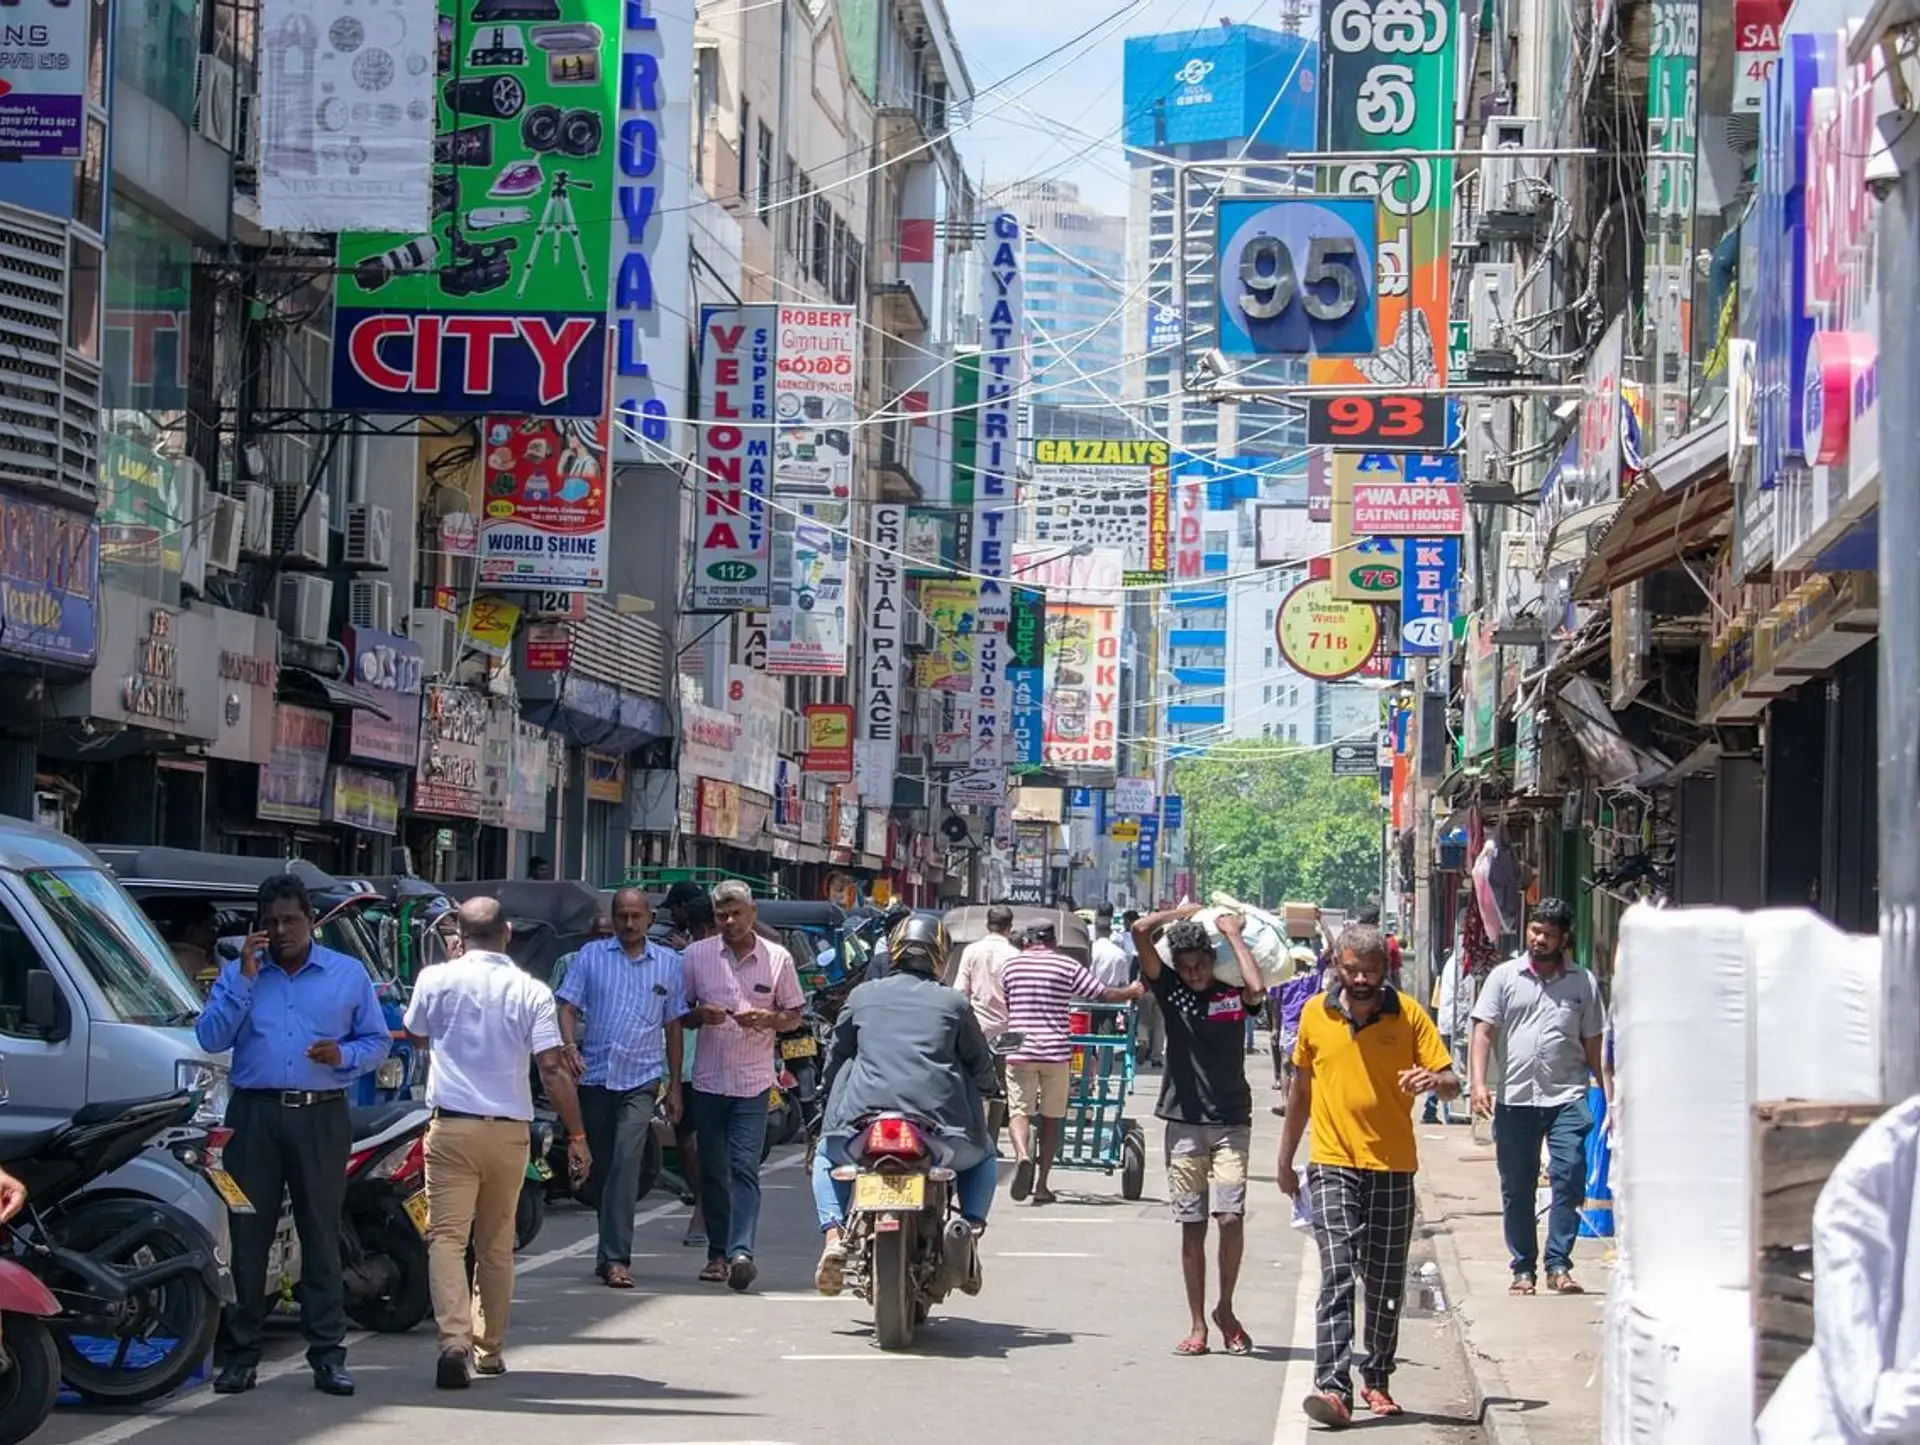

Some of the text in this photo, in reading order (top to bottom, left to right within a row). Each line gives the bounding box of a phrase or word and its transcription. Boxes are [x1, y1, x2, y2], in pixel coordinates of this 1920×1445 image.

[614, 52, 658, 377] ROYAL
[1238, 234, 1357, 322] 95
[781, 310, 851, 327] ROBERT
[349, 314, 596, 405] CITY
[703, 325, 746, 549] VELONNA
[747, 328, 768, 550] SUPER MARKET
[1328, 396, 1424, 436] 93
[1036, 440, 1168, 464] GAZZALYS
[1355, 508, 1460, 521] EATING HOUSE
[1366, 488, 1450, 505] WAAPPA
[488, 533, 596, 554] WORLD SHINE
[980, 512, 1004, 594] TEX
[1178, 484, 1201, 577] JDM
[718, 564, 747, 579] 112
[1358, 571, 1397, 586] 75
[869, 510, 898, 740] CRYSTAL PALACE
[1307, 603, 1350, 613] Sheema
[1094, 610, 1117, 741] TOKYO
[978, 715, 996, 748] MAX
[1014, 671, 1031, 762] FASHIONS
